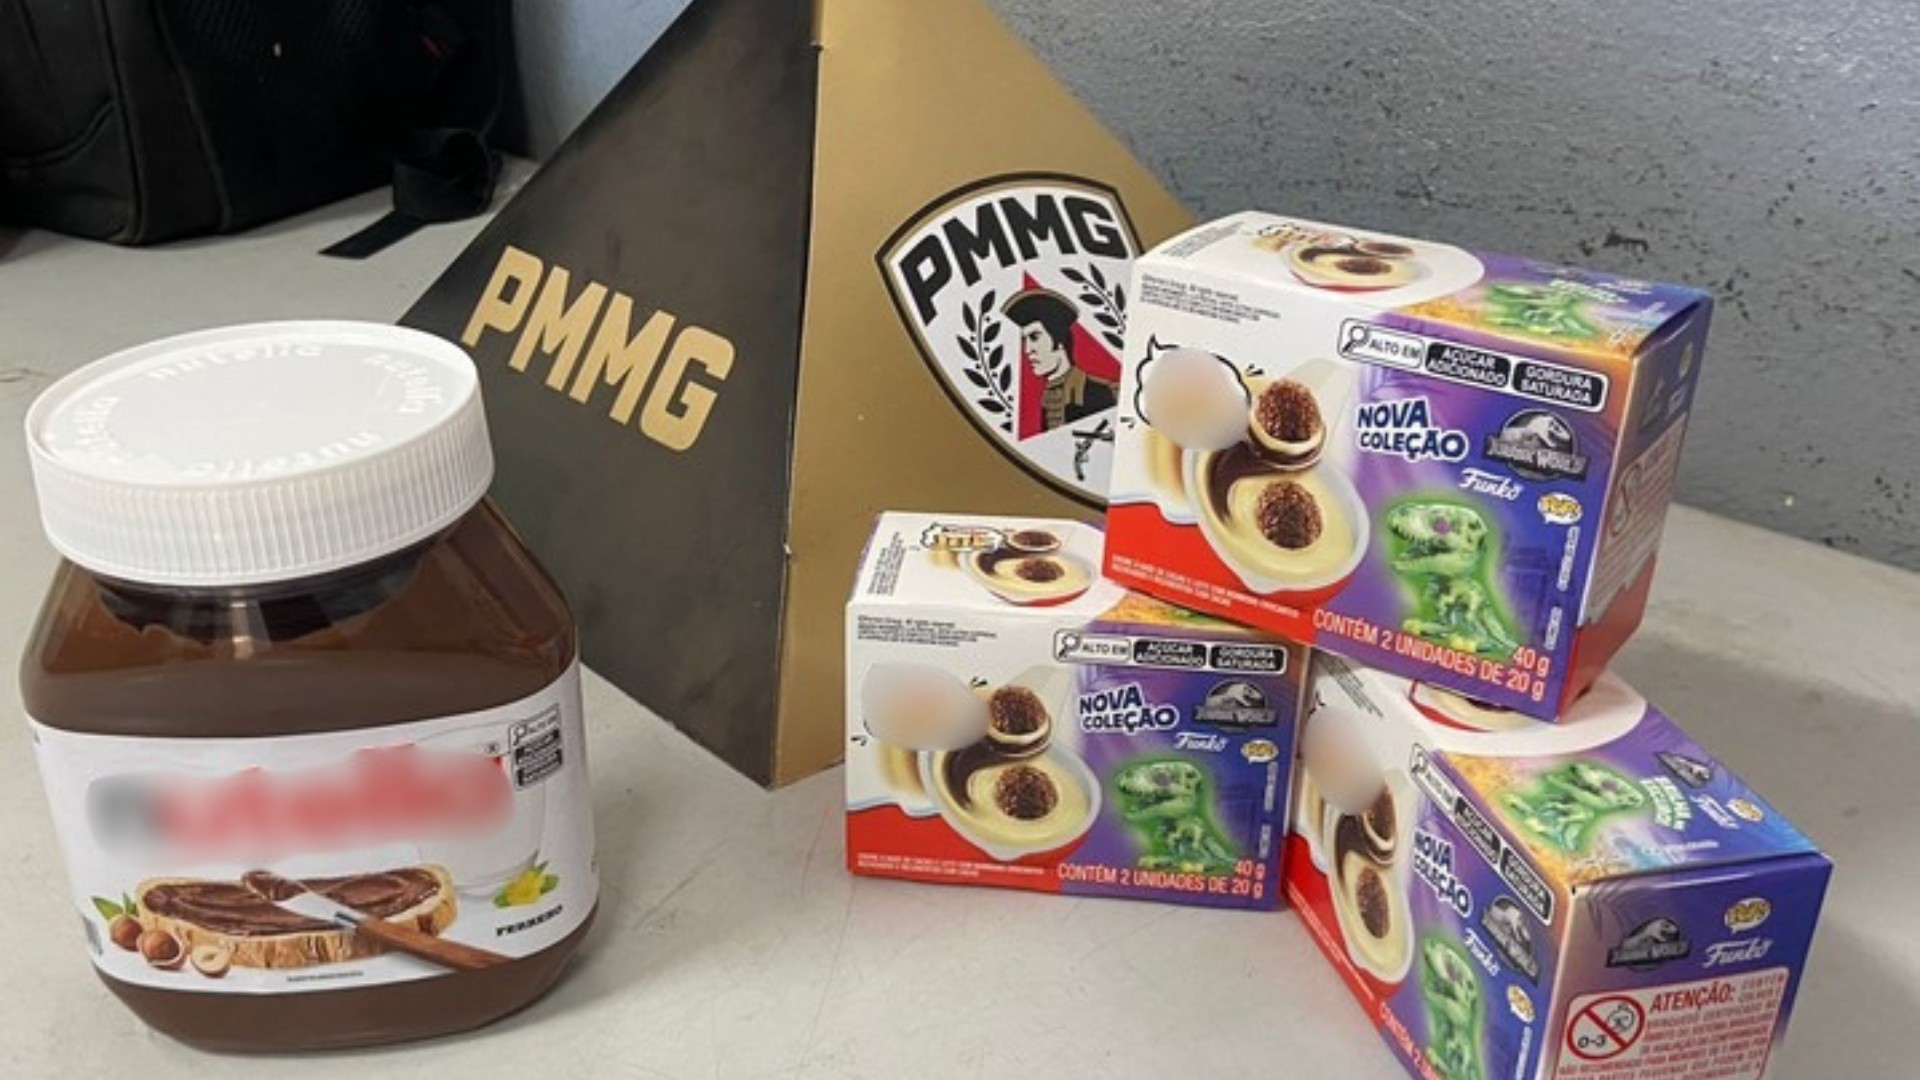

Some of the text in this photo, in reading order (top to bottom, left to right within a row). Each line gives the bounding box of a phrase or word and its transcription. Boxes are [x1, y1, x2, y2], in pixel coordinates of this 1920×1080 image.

[898, 194, 1129, 326] PMMG
[460, 244, 736, 451] PMMG
[1369, 339, 1420, 360] ALTO EM
[1426, 360, 1506, 387] ADICIONADO
[1525, 365, 1593, 390] GORDURA
[1521, 379, 1592, 405] SATURADA
[1358, 401, 1429, 428] NOVA
[1361, 430, 1467, 460] COLEÇÃO
[1082, 643, 1109, 654] ALTO
[1312, 608, 1546, 702] CONTÉM 2 UNIDADES DE 20 g
[1513, 646, 1550, 680] 40 g
[1080, 686, 1143, 714] NOVA
[1083, 708, 1178, 733] COLEÇÃO
[1415, 831, 1451, 873] NOVA
[1058, 862, 1117, 884] CONTÉM
[1119, 869, 1131, 886] 2
[1132, 870, 1204, 893] UNIDADES
[1207, 876, 1228, 894] DE
[1231, 879, 1250, 896] 20
[1252, 882, 1265, 900] g
[1233, 859, 1266, 881] 40 g
[1415, 854, 1470, 914] COLEÇÃO
[1650, 981, 1736, 1013] ATENÇÃO:
